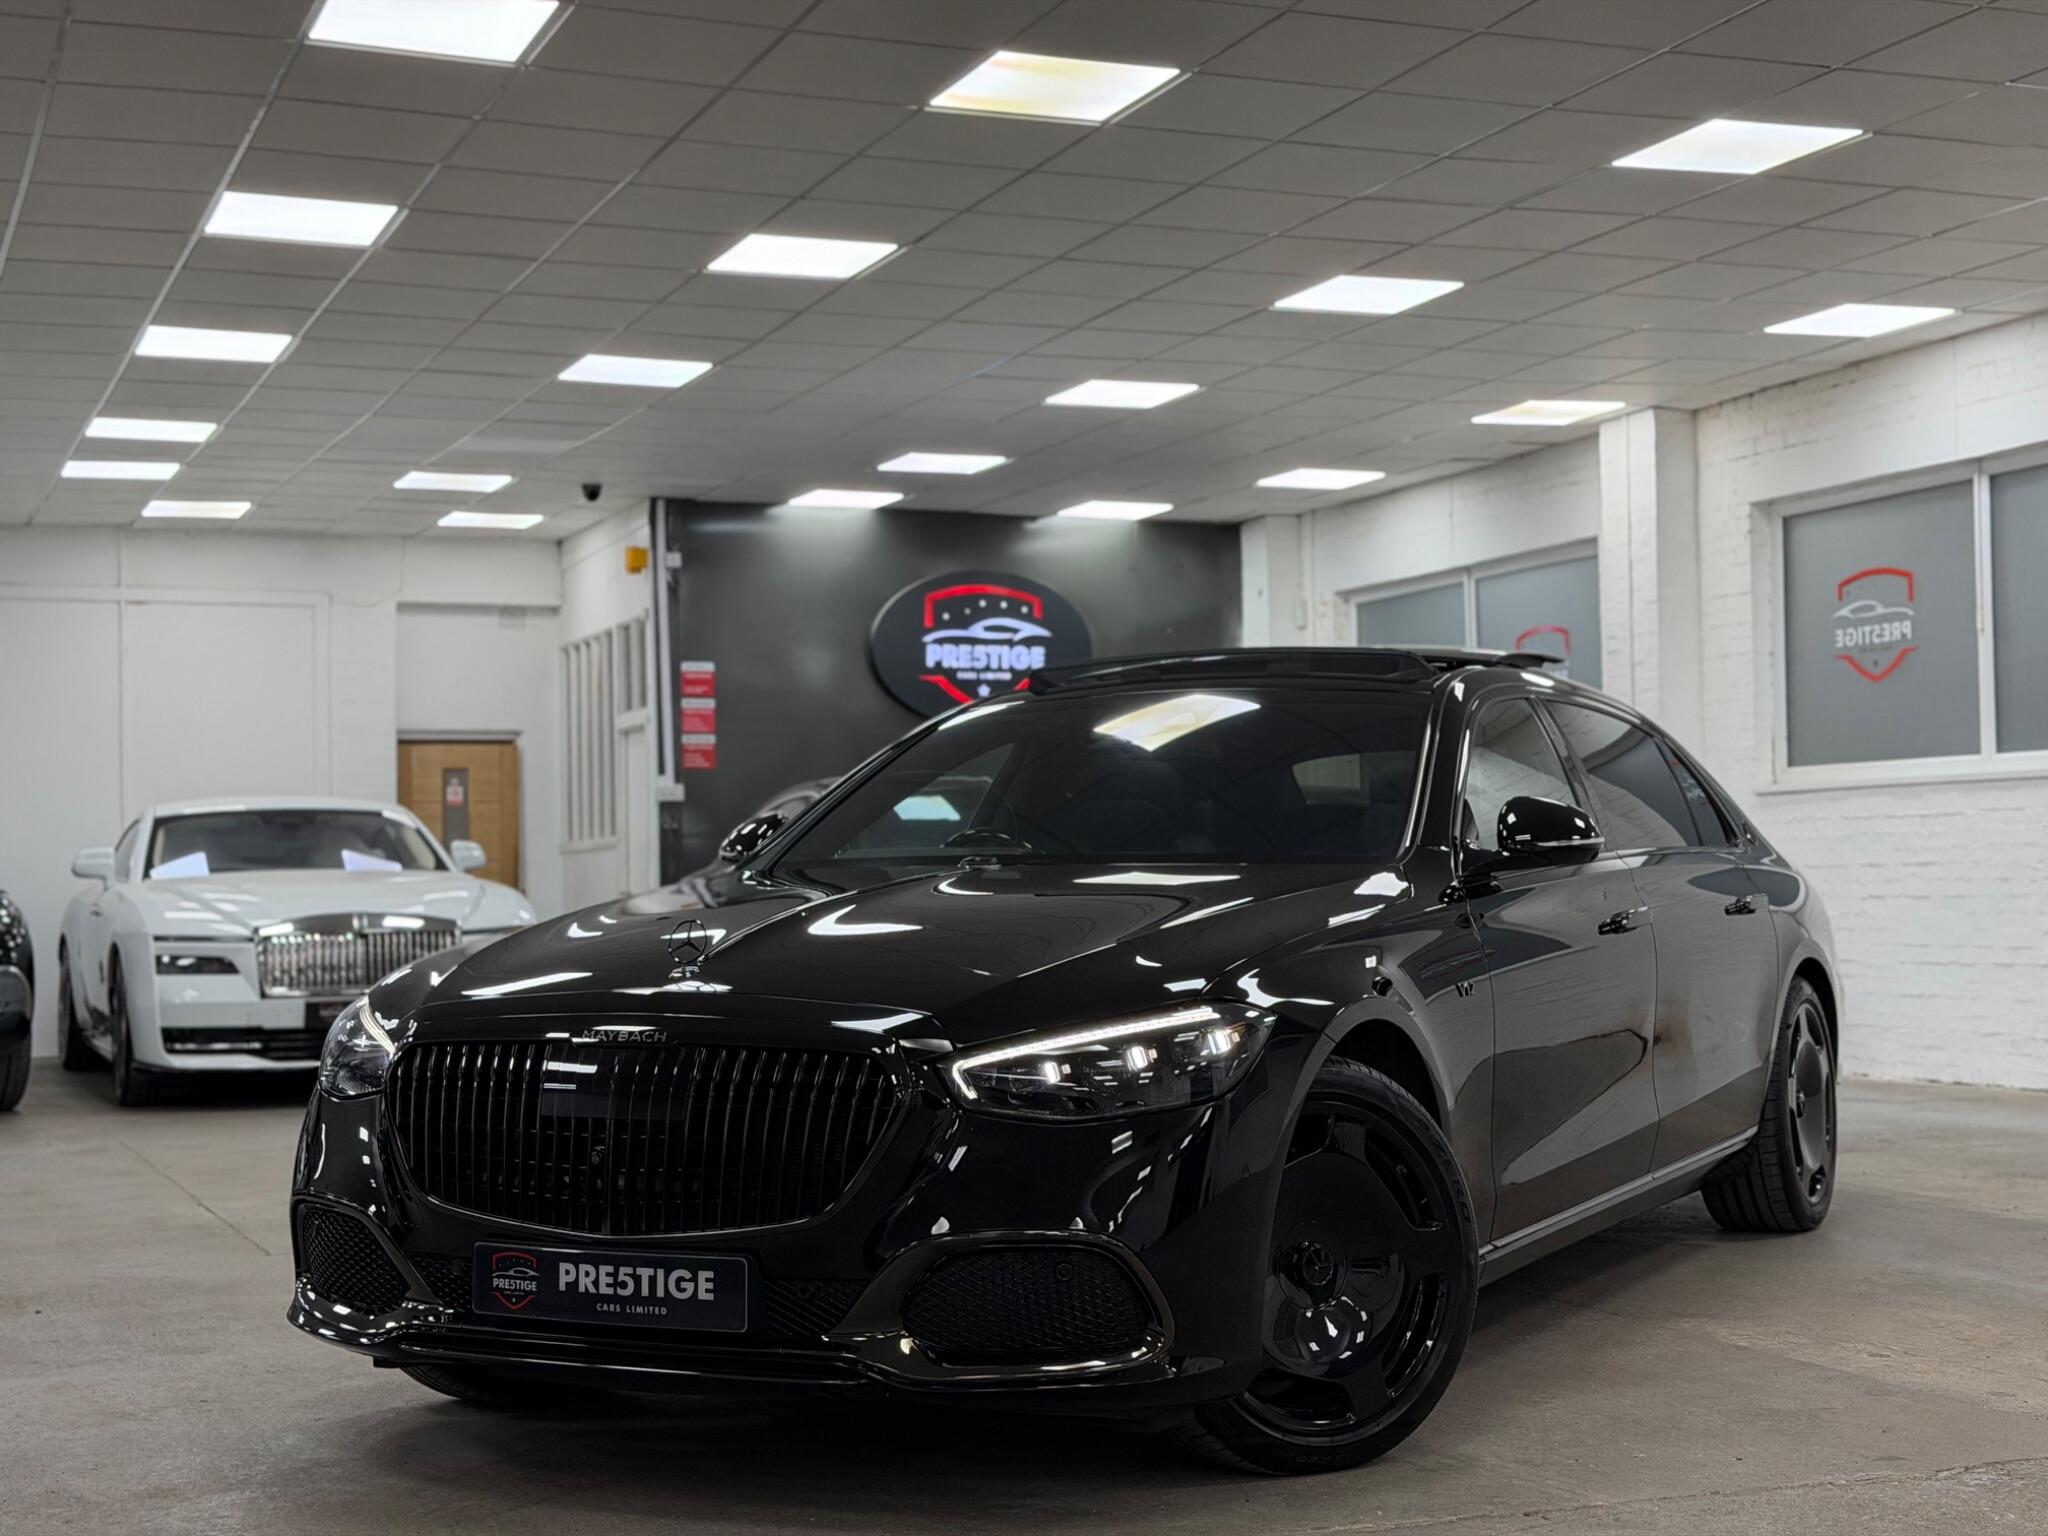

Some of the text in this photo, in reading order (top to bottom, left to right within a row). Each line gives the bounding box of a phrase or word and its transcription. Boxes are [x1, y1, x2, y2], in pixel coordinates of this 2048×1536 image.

[582, 1030, 667, 1042] MAYBACH
[596, 1303, 668, 1316] CARS LIMITED
